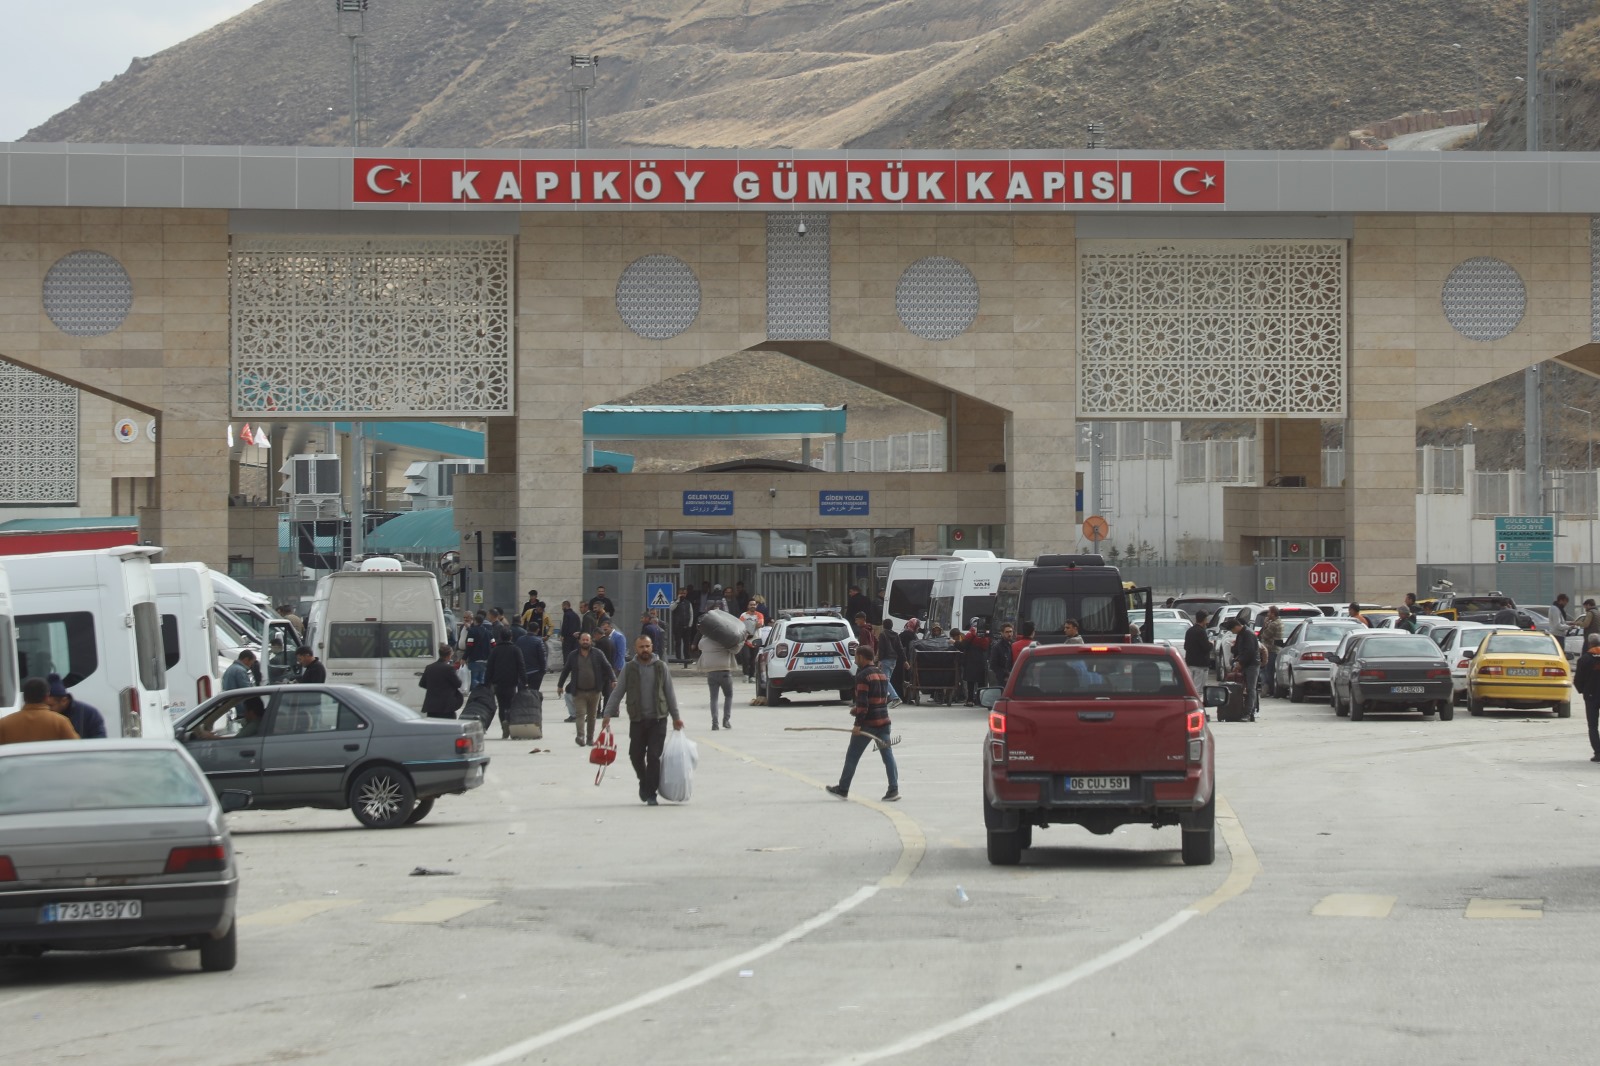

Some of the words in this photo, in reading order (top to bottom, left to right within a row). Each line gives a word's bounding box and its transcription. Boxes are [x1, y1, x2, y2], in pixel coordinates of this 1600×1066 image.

[451, 162, 705, 200] KAPIKÖY
[733, 162, 945, 201] GÜMRÜK
[966, 171, 1132, 201] KAPISI
[1311, 572, 1338, 584] DUR
[339, 628, 374, 637] OKUL
[1071, 778, 1084, 789] 06
[1087, 778, 1107, 789] CUJ
[1109, 778, 1128, 788] 591
[60, 901, 139, 919] 73AB970
